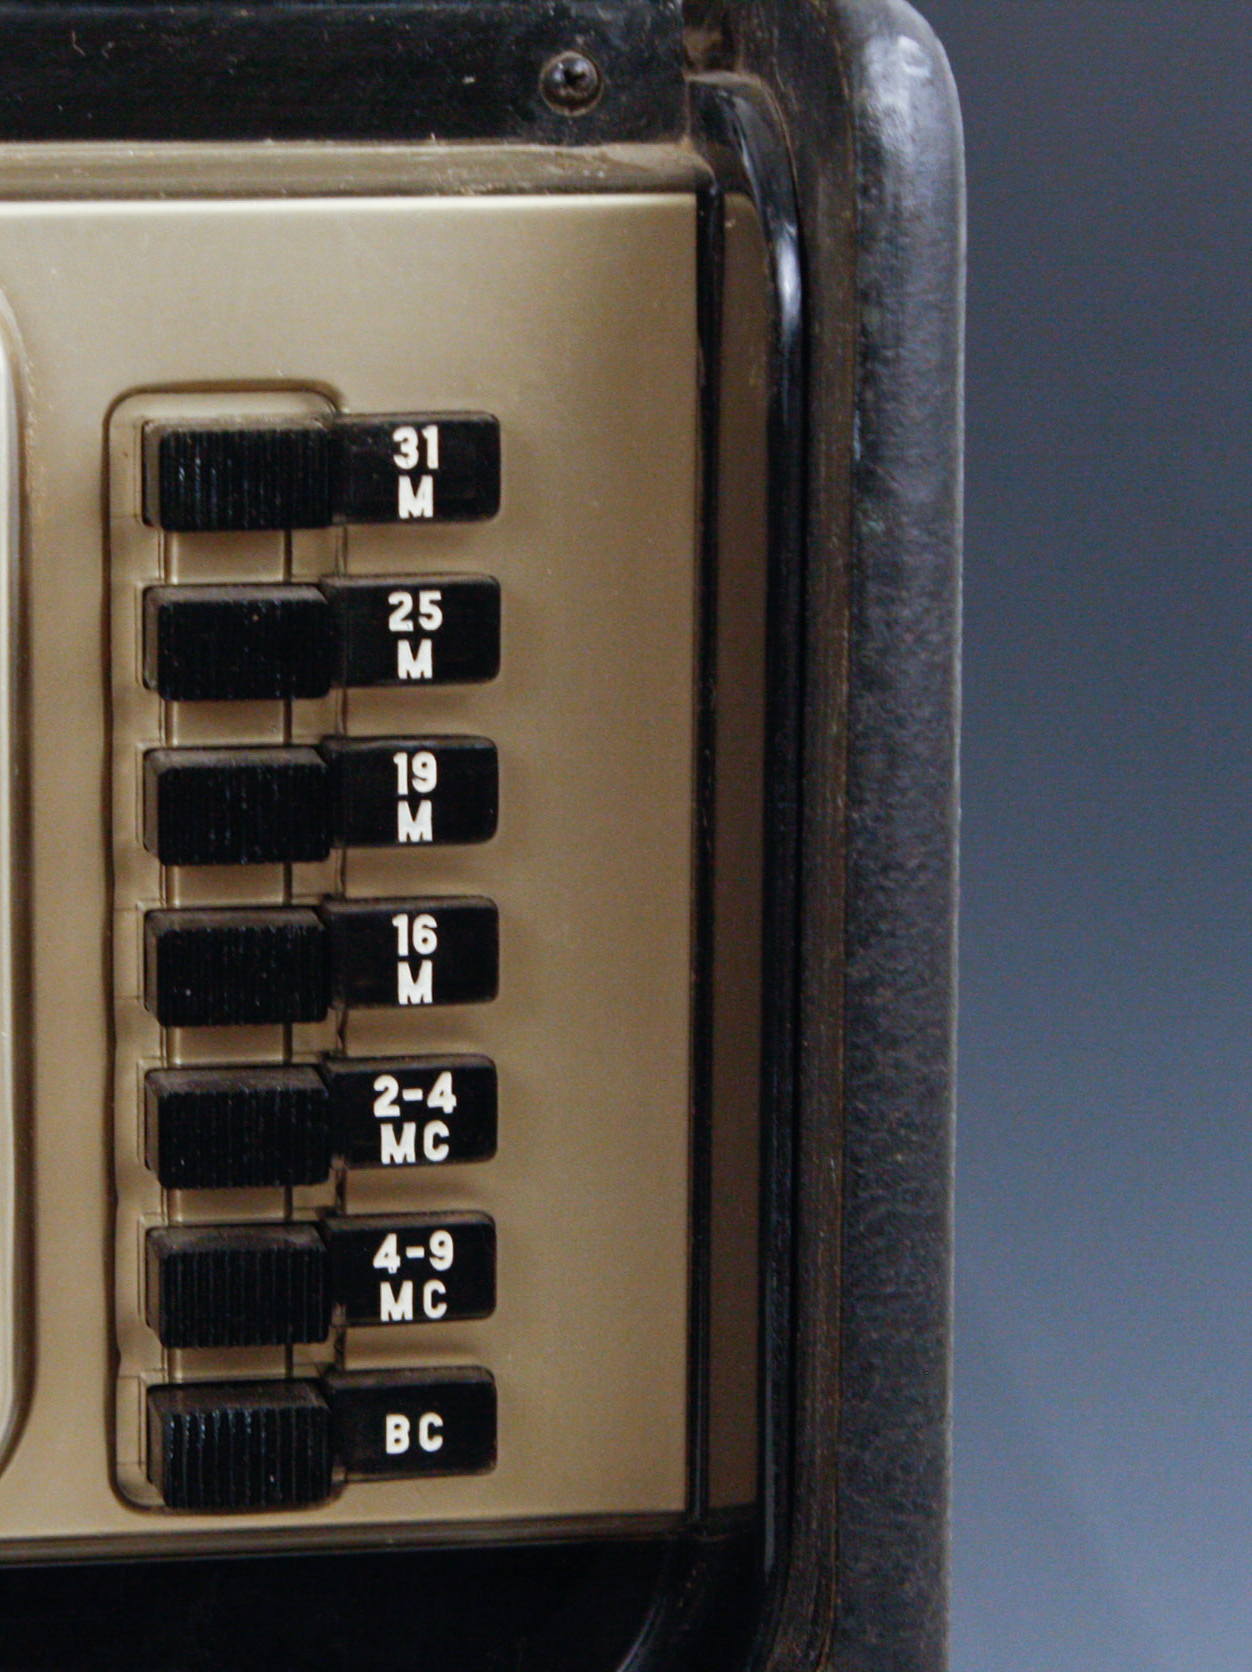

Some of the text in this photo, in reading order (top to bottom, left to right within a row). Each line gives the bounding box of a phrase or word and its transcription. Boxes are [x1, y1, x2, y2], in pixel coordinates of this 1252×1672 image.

[391, 425, 441, 470] 31
[397, 475, 435, 519] M
[387, 590, 443, 632] 25
[396, 638, 434, 680] M
[391, 751, 438, 796] 19
[396, 799, 434, 844] M
[391, 913, 439, 957] 16
[396, 959, 434, 1006] M
[372, 1071, 457, 1119] 2-4
[379, 1120, 451, 1166] MC
[372, 1230, 455, 1276] 4-9
[379, 1279, 448, 1323] MC
[384, 1411, 445, 1456] BC
